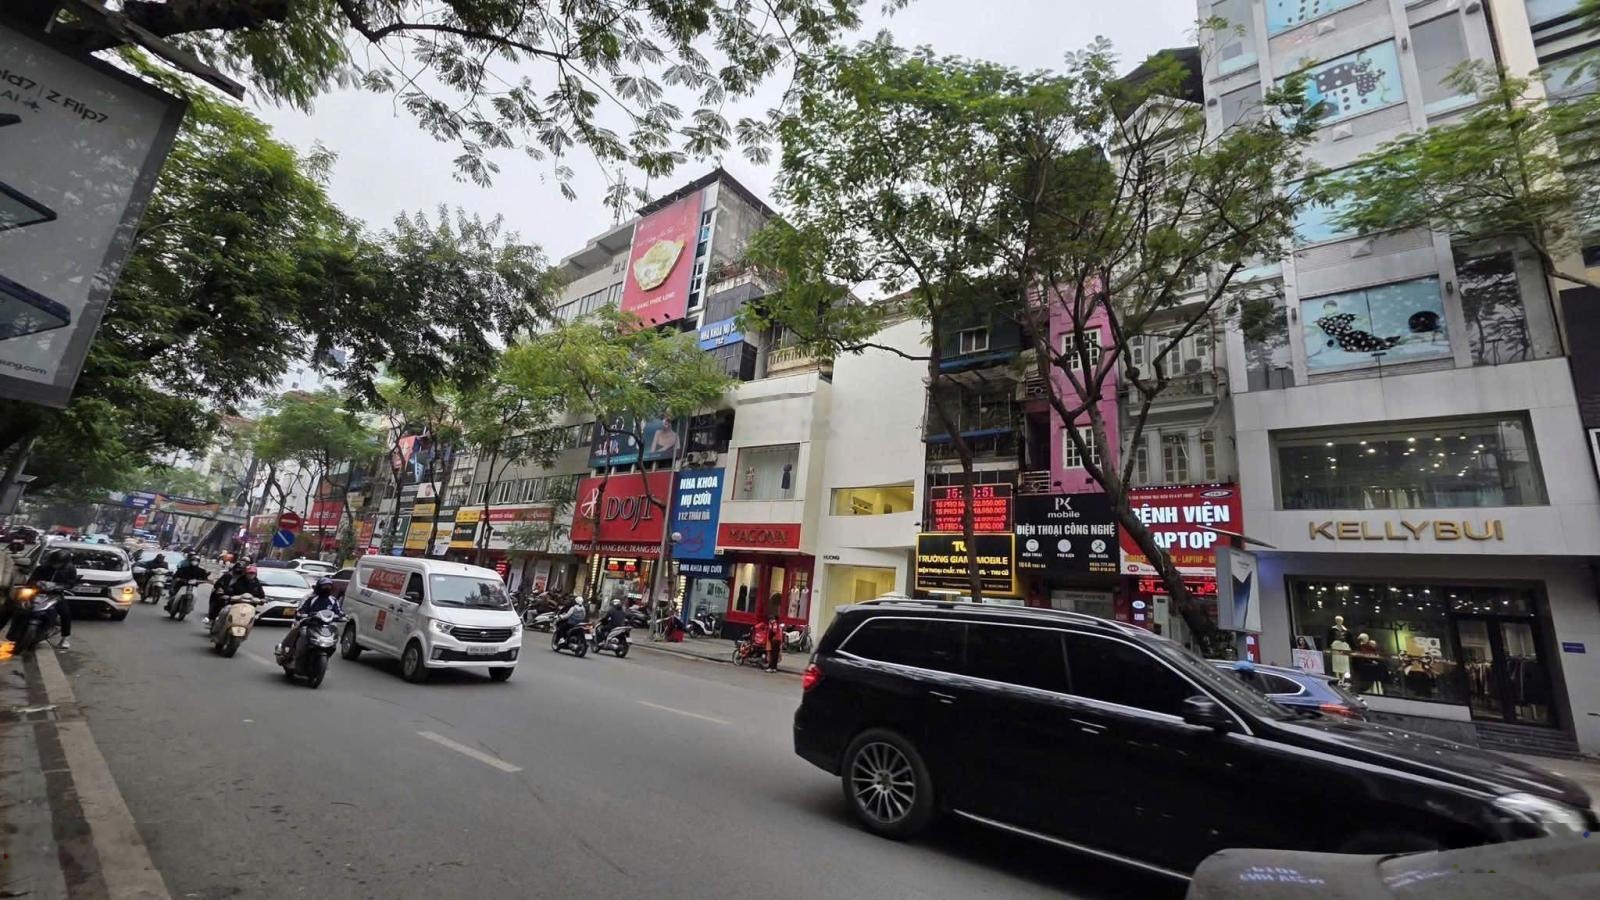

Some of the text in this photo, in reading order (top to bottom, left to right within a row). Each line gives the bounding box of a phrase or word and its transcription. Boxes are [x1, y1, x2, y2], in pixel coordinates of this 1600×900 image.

[0, 69, 108, 123] ld7 Z Flip7
[680, 476, 718, 490] NHA KHOA
[680, 491, 712, 508] NỤ CƯỜI
[604, 495, 654, 531] DOJI
[678, 512, 688, 520] 112
[1183, 501, 1230, 526] VIỆN
[1016, 522, 1115, 537] ĐIỆN THOẠI CÔNG NGHỆ
[1153, 531, 1217, 549] APTOP
[976, 556, 1008, 565] MOBILE
